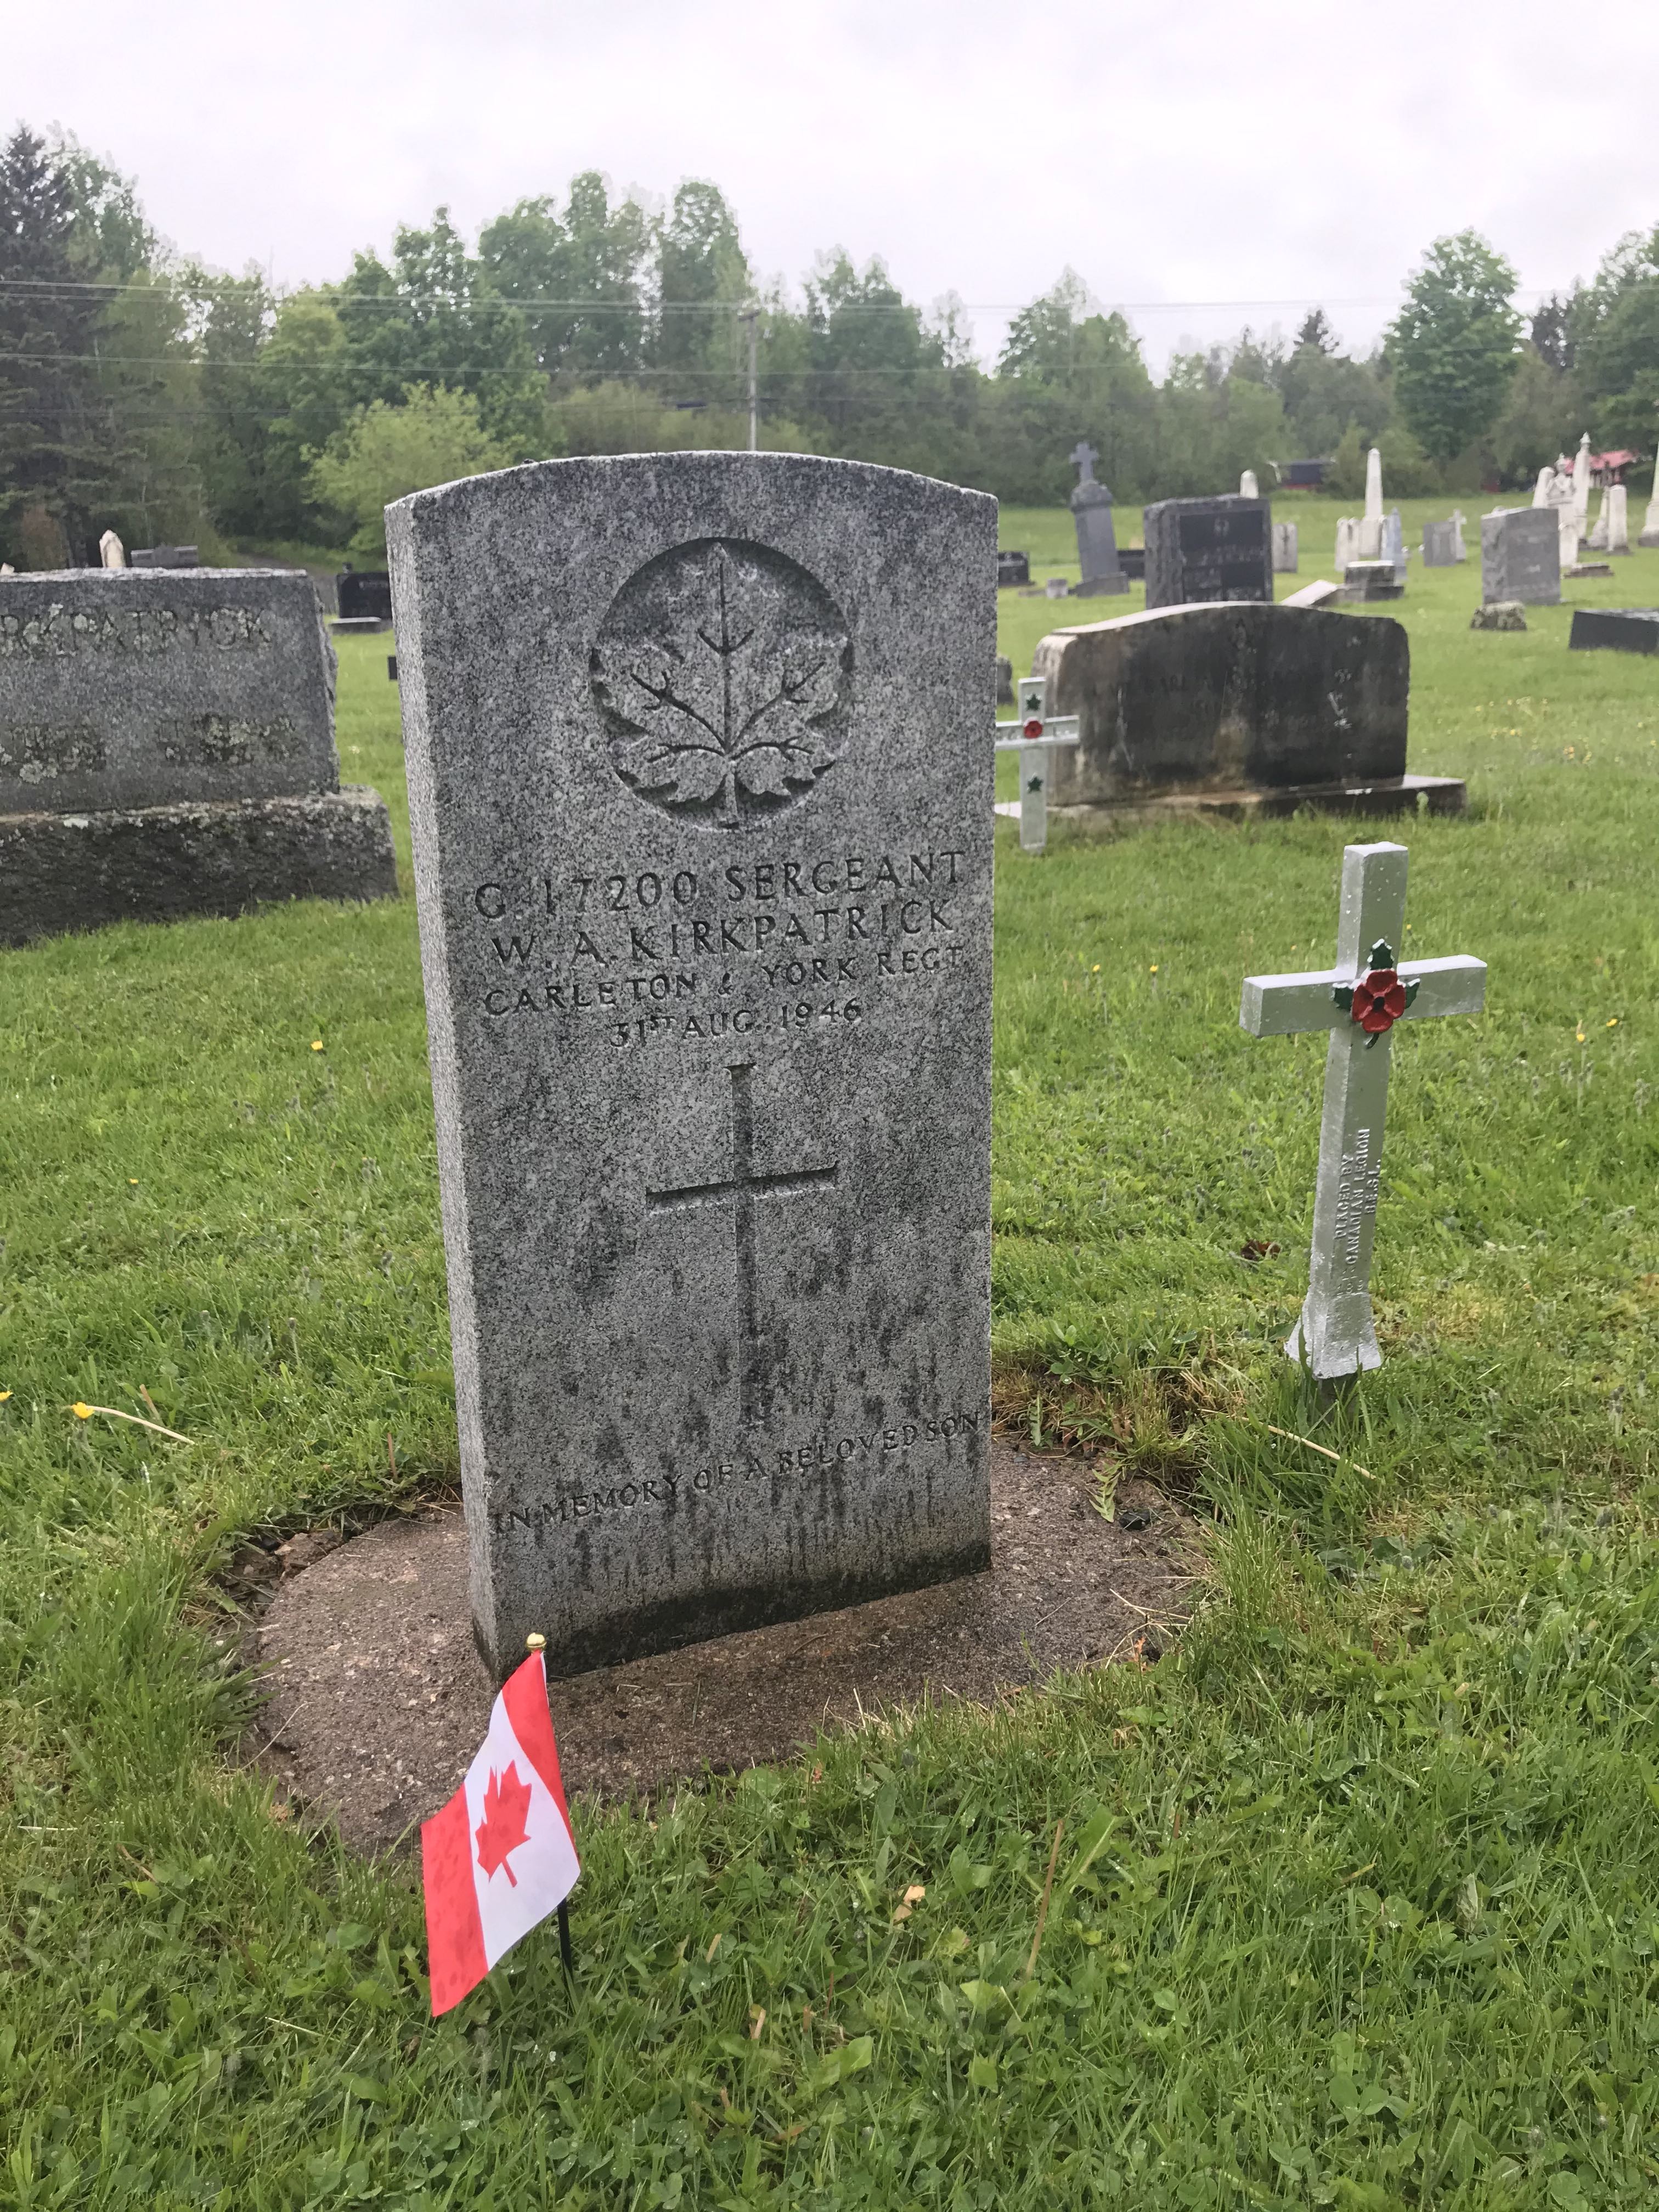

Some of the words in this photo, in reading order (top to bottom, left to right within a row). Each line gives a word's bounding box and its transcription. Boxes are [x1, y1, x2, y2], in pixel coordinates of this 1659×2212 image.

[725, 850, 966, 903] SERGEANT
[485, 973, 697, 1017] CARLETON
[716, 972, 733, 997] &
[761, 956, 857, 988] YORK
[877, 945, 963, 976] REGT
[781, 997, 862, 1029] 1946
[1339, 1154, 1354, 1177] BY
[1353, 1128, 1370, 1182] LEGION
[1333, 1182, 1351, 1240] PLACED
[1345, 1188, 1364, 1265] CANADIAN
[493, 1506, 532, 1536] IN
[541, 1472, 684, 1523] MEMORY
[693, 1463, 734, 1491] OF
[744, 1453, 770, 1482] A
[777, 1425, 919, 1475] BELOVED
[927, 1410, 981, 1442] SON
